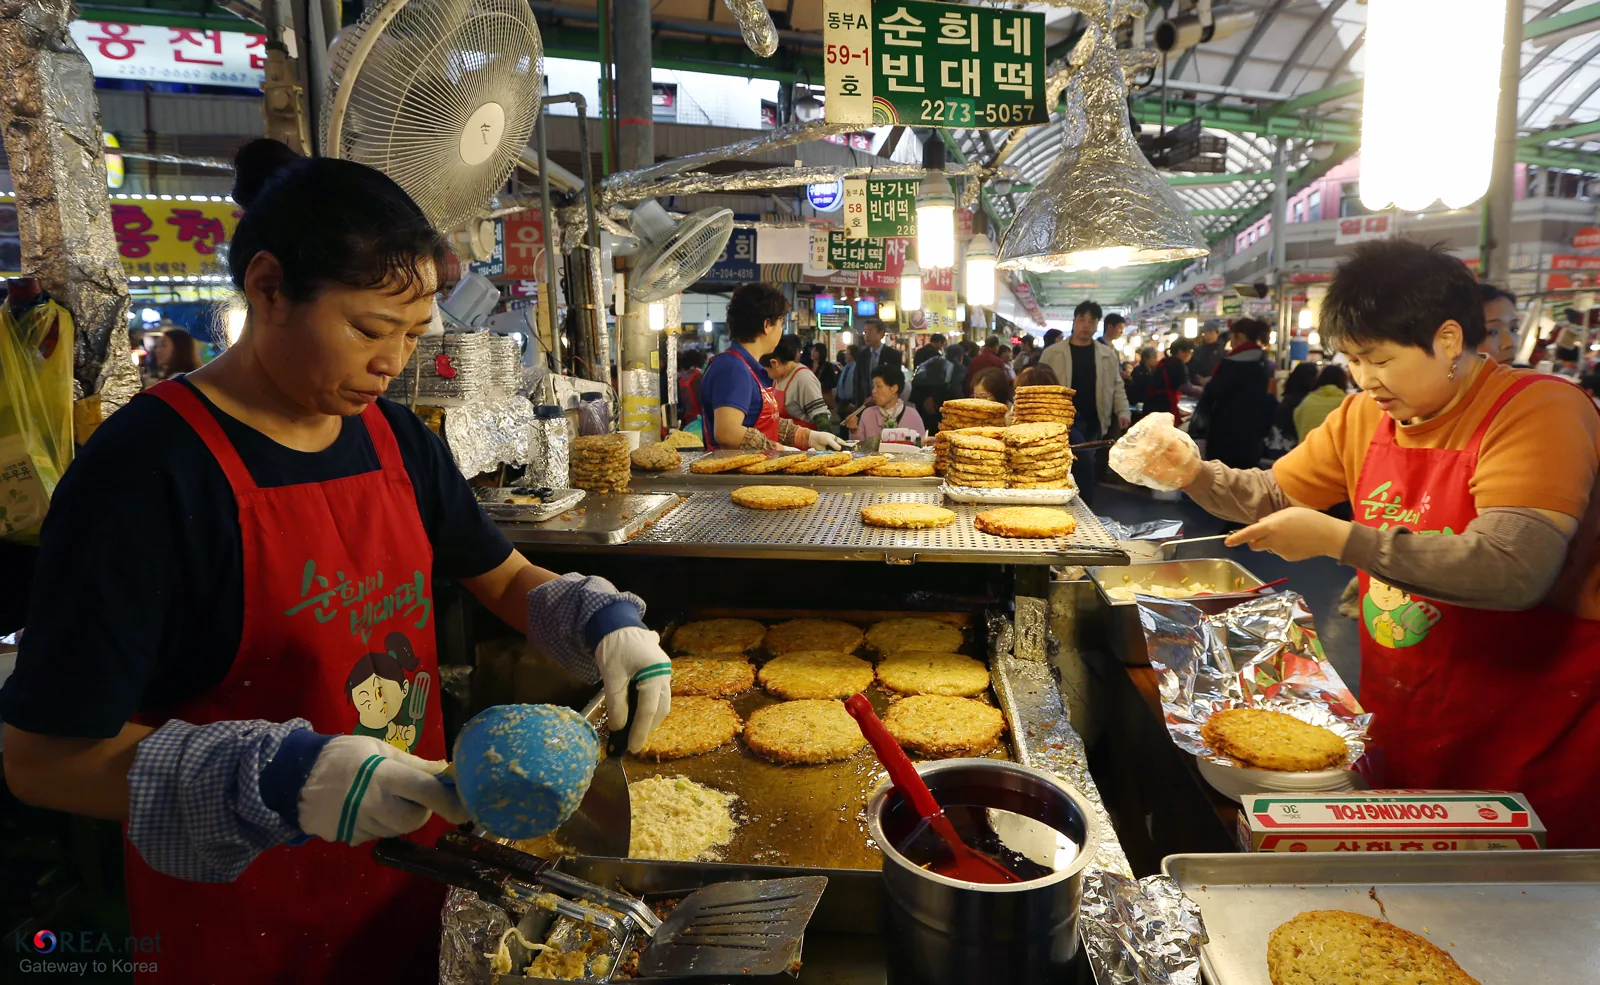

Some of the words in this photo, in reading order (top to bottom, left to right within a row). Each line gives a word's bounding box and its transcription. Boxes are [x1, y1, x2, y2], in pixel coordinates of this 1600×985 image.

[827, 12, 868, 30] 동부A
[878, 7, 1031, 56] 순희네
[826, 44, 869, 66] 59-1
[882, 53, 1033, 100] 빈대떡
[839, 75, 861, 96] 호
[920, 99, 1035, 122] 2273-5057
[846, 189, 865, 197] 동부A
[870, 182, 919, 198] 박가네
[848, 203, 863, 213] 58
[852, 217, 862, 227] 호
[896, 225, 916, 236] 226
[832, 248, 883, 261] 빈대떡
[842, 261, 882, 269] 2264-0847
